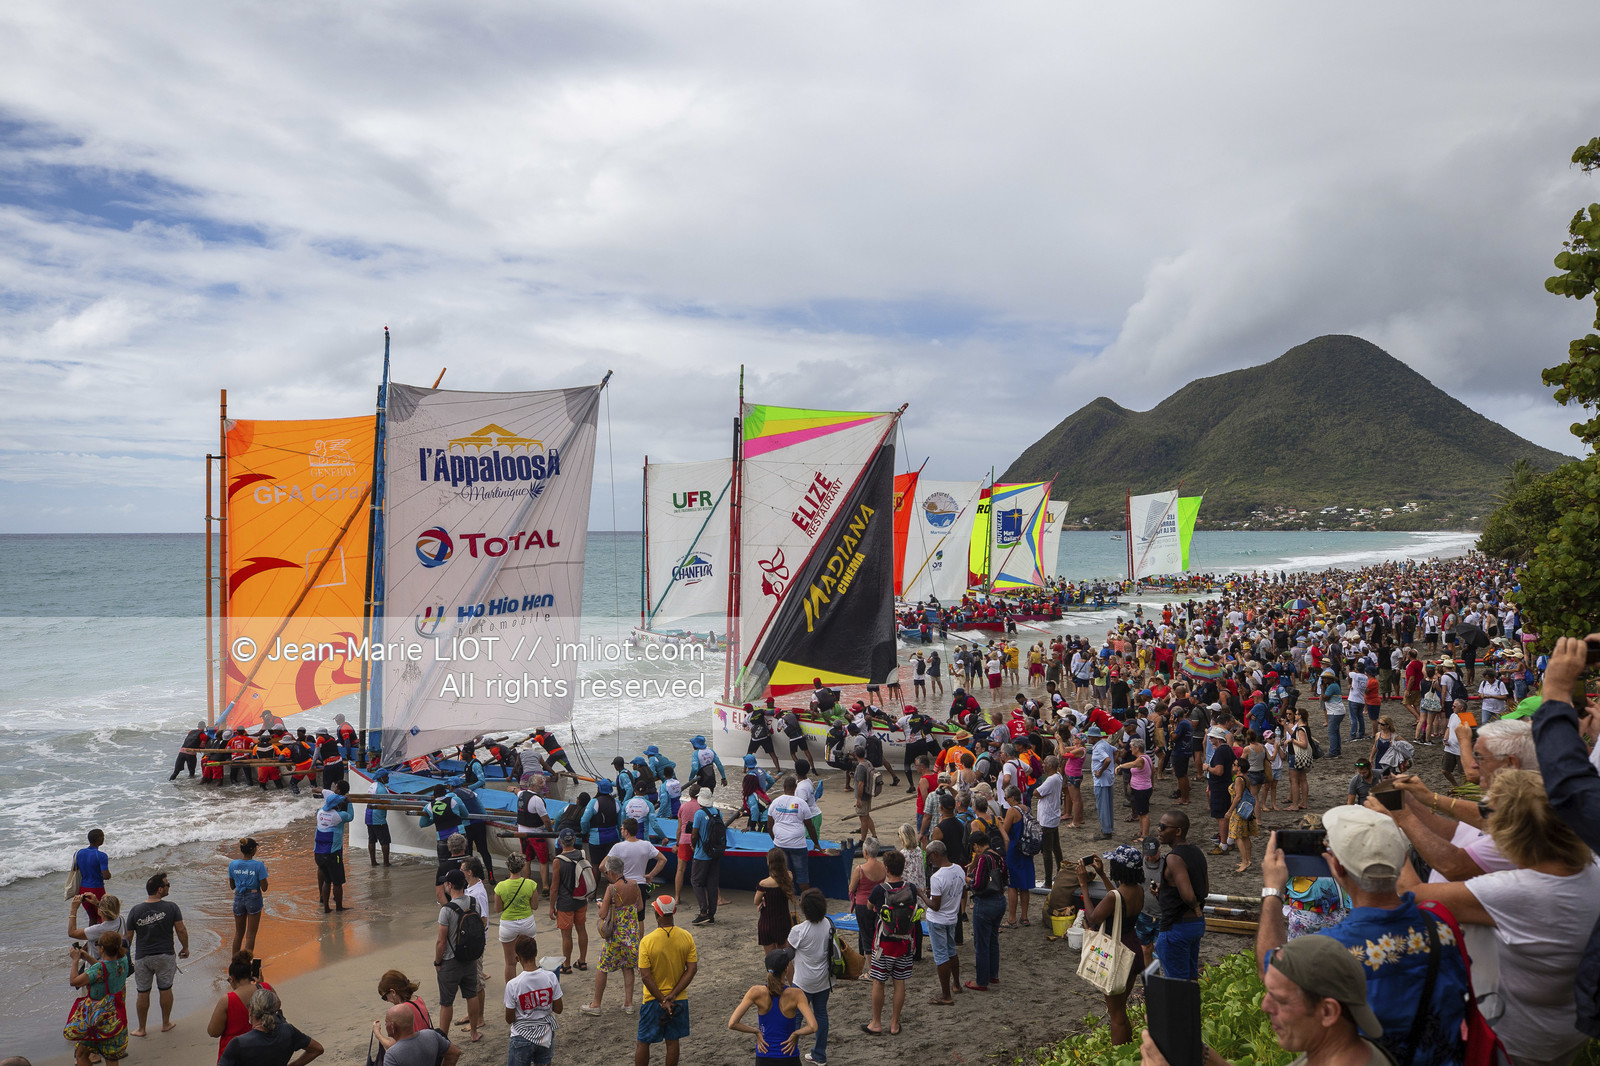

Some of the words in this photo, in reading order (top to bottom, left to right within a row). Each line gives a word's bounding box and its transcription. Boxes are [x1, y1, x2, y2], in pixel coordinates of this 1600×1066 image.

[253, 484, 305, 505] GFA
[672, 490, 713, 509] UFR
[791, 471, 833, 532] ÉLIZÉ
[806, 477, 844, 539] RESTAURANT
[459, 529, 560, 559] TOTAL
[803, 504, 875, 632] MADIANA
[457, 603, 486, 624] Ho
[488, 597, 519, 616] Hio
[521, 593, 555, 612] Hen
[637, 632, 650, 642] UFR
[800, 724, 828, 737] DIANA
[877, 732, 894, 743] XL
